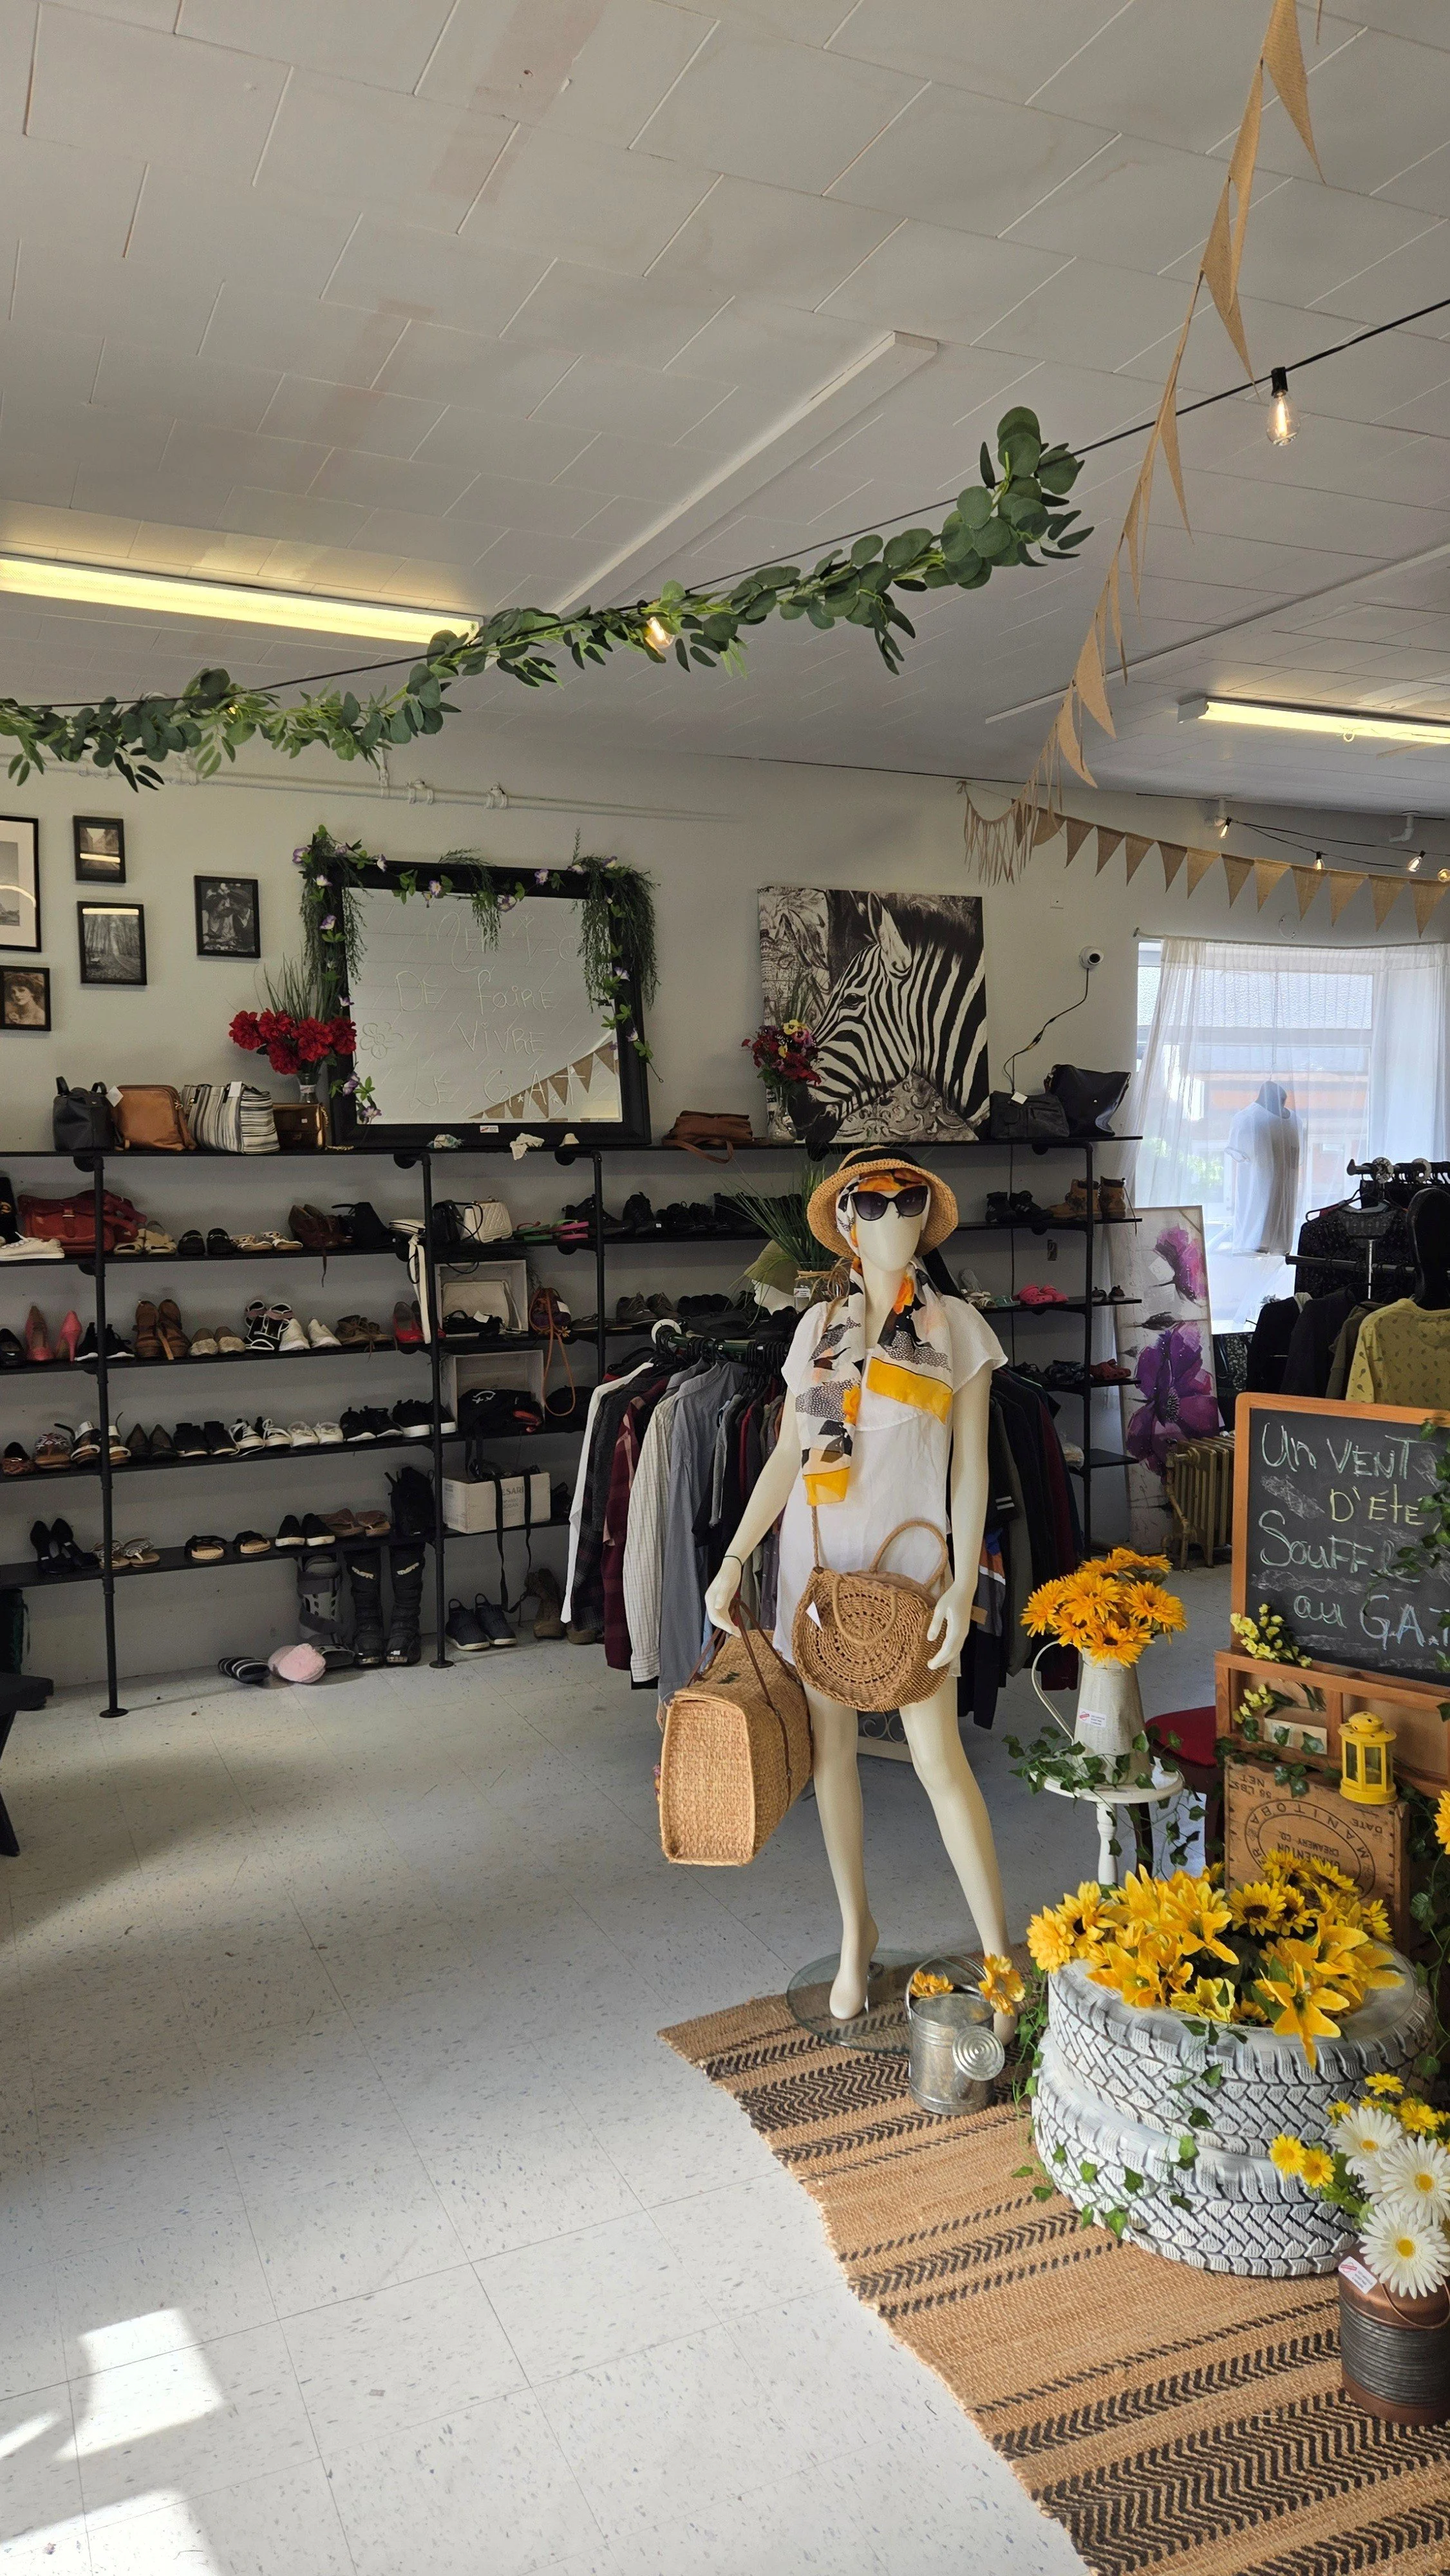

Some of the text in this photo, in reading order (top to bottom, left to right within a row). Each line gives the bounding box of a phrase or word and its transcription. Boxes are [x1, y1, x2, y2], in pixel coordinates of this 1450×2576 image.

[395, 971, 440, 1013] DE
[1261, 1422, 1437, 1480] Un VENT
[1293, 1595, 1348, 1629] au
[1238, 1774, 1265, 1788] NET
[1259, 1789, 1272, 1799] 56
[1249, 1802, 1370, 1859] MANITOBA
[1351, 1817, 1383, 1835] DATE
[1297, 1837, 1340, 1857] CREAMERY
